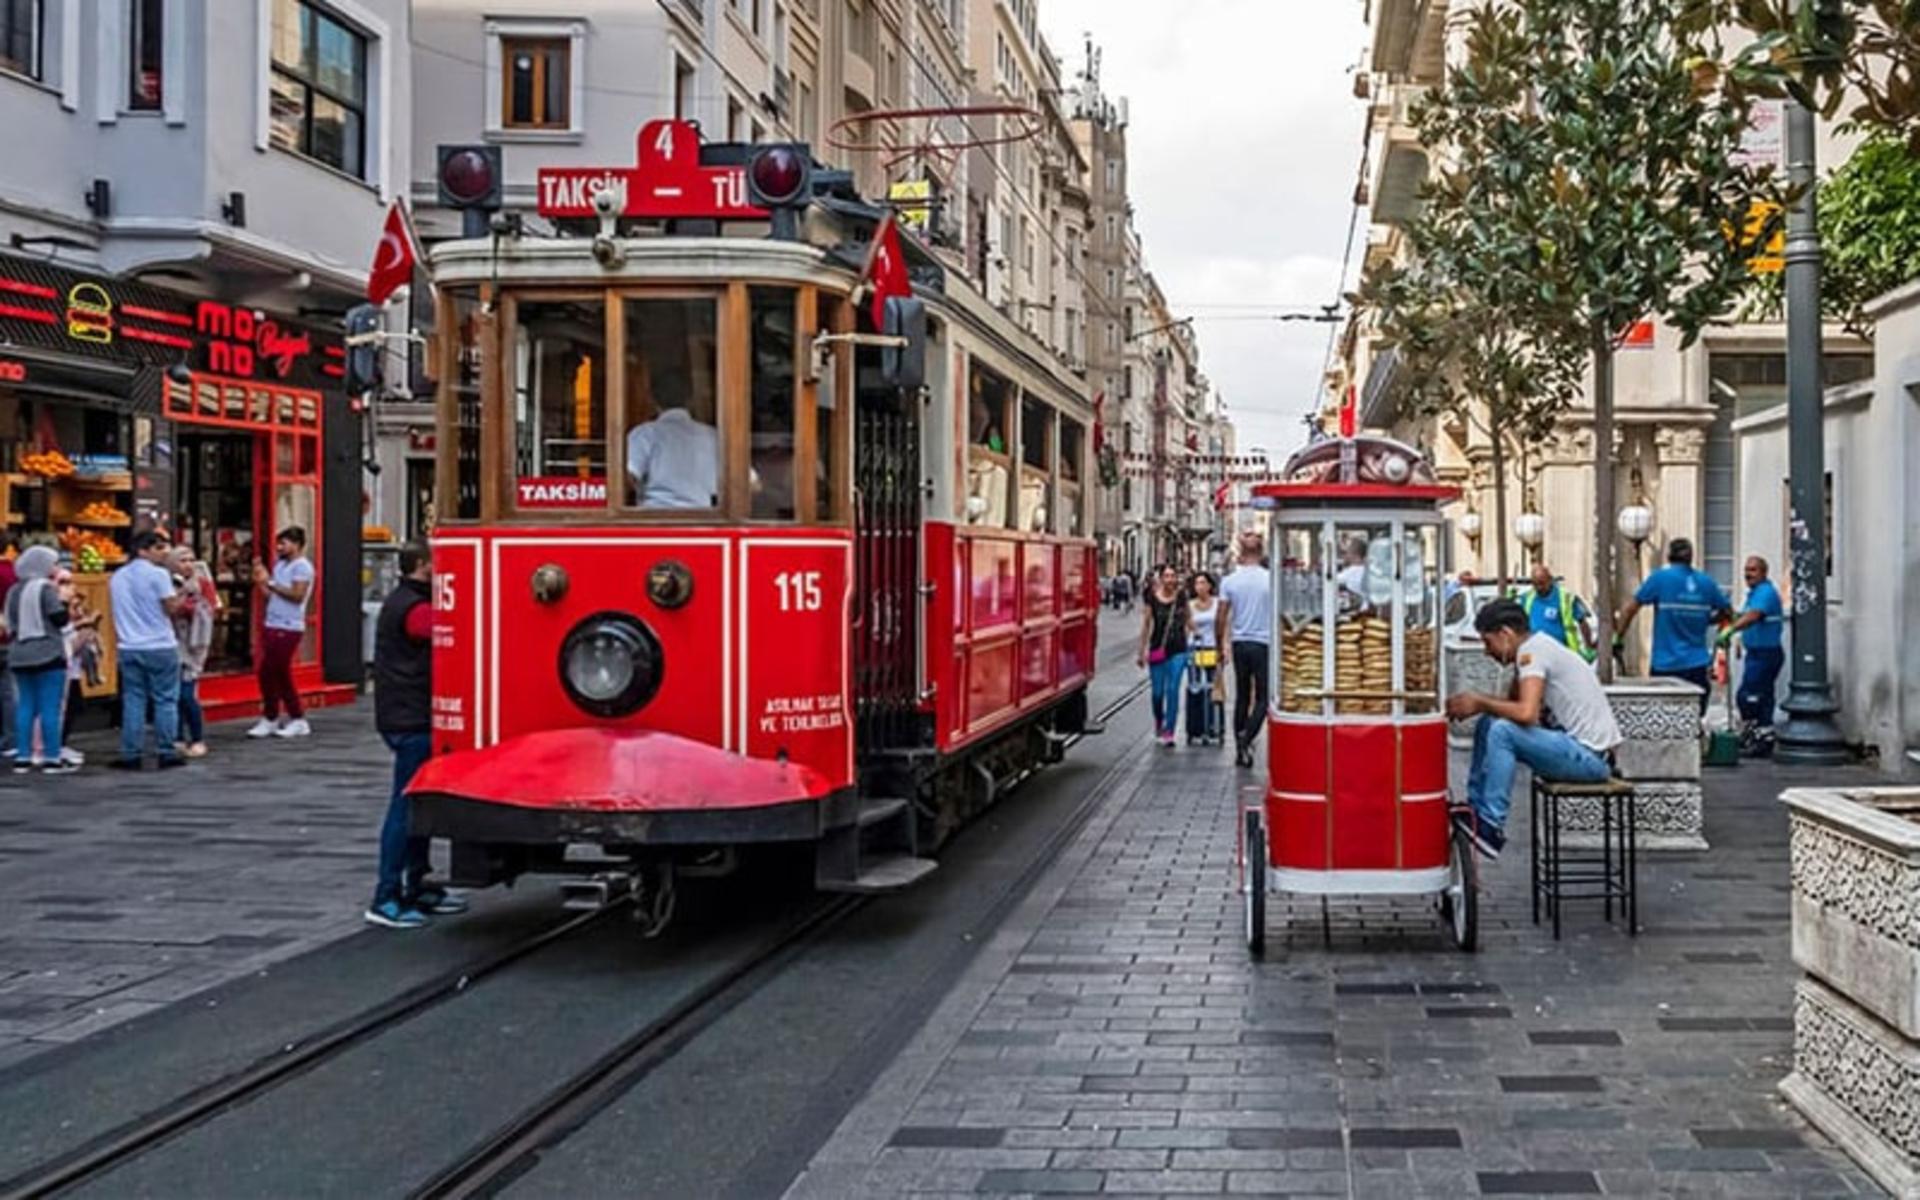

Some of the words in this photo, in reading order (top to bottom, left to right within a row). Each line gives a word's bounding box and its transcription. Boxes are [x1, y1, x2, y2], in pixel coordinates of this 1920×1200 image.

[655, 124, 674, 160] 4
[711, 171, 749, 208] TÜ
[520, 481, 606, 501] TAKSİM
[774, 571, 822, 611] 115
